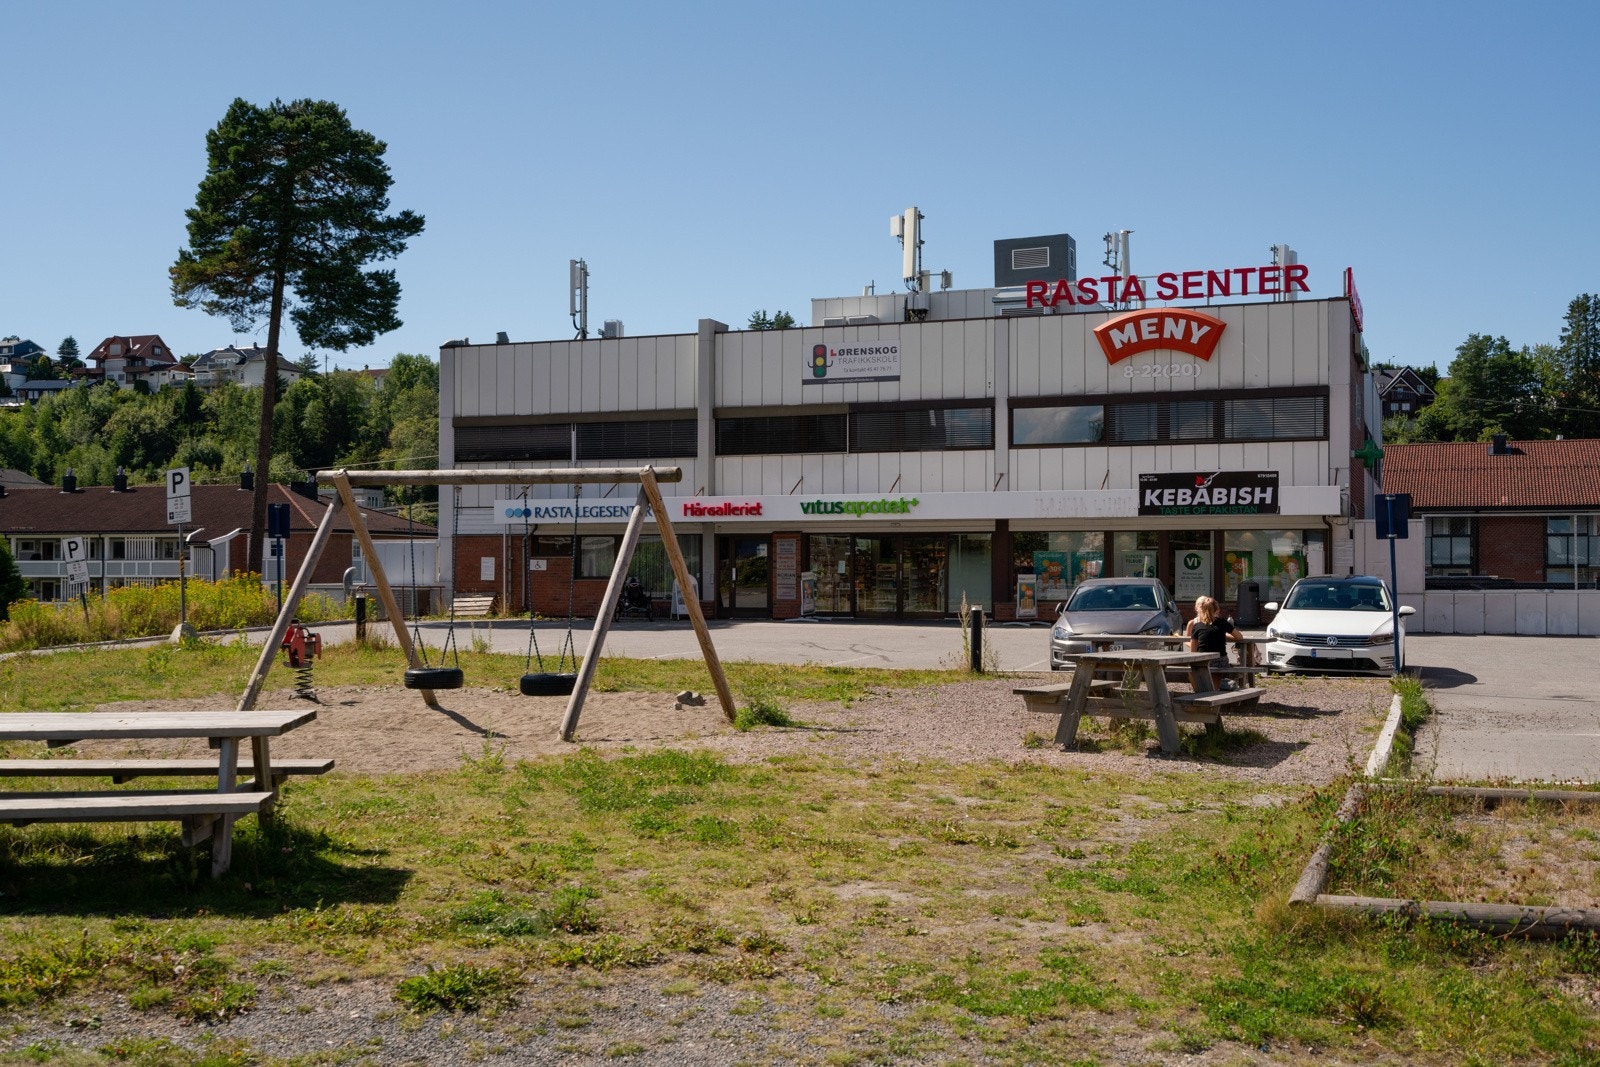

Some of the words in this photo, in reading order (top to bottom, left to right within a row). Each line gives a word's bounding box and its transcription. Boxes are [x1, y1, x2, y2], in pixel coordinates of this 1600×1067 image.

[1026, 275, 1146, 308] RASTA
[1156, 264, 1311, 301] SENTER
[1108, 317, 1211, 350] MENY
[830, 346, 898, 357] LØRENSKOG
[838, 355, 898, 365] TRAFIKKSKOLE
[1123, 363, 1201, 379] 8-22(20)
[172, 471, 184, 494] P
[1144, 486, 1273, 506] KEBABISH
[534, 506, 573, 518] RASTA
[576, 505, 653, 518] LEGESENTR
[1160, 506, 1190, 515] TASTE
[1193, 506, 1206, 515] OF
[1209, 505, 1258, 514] PAKISTAN
[67, 540, 79, 559] P
[1186, 557, 1198, 567] VI
